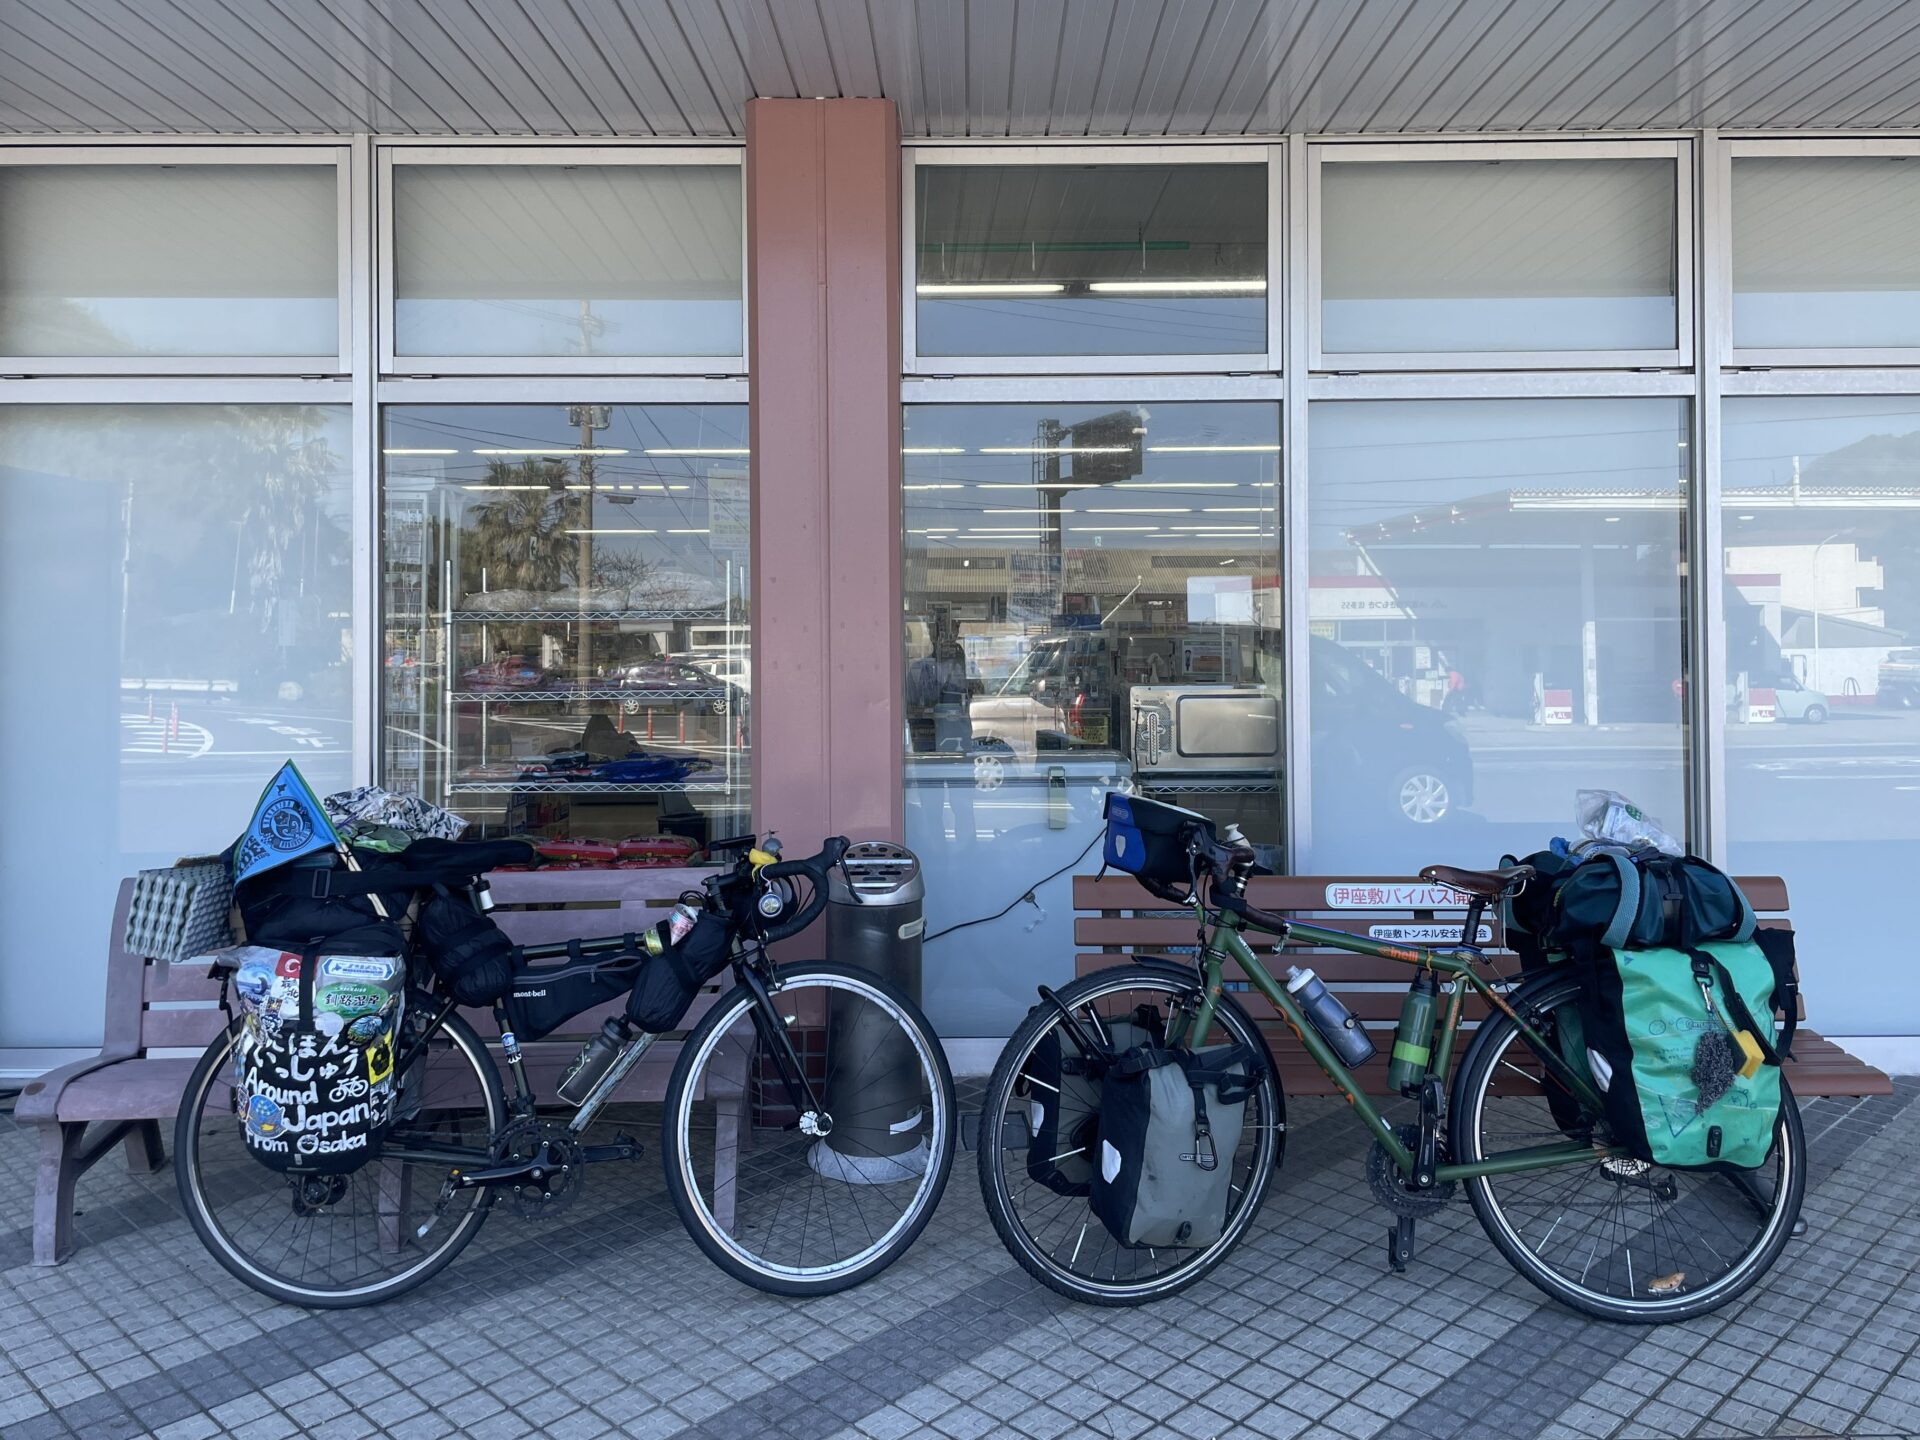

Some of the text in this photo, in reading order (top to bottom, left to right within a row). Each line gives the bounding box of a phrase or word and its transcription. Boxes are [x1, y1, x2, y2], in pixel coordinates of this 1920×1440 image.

[1333, 887, 1471, 906] 伊座敷バイパス開
[1373, 928, 1488, 939] 伊座敷トンネル安全会
[245, 1066, 319, 1104] Around
[282, 1102, 371, 1137] Japan
[297, 1130, 367, 1154] Osaka
